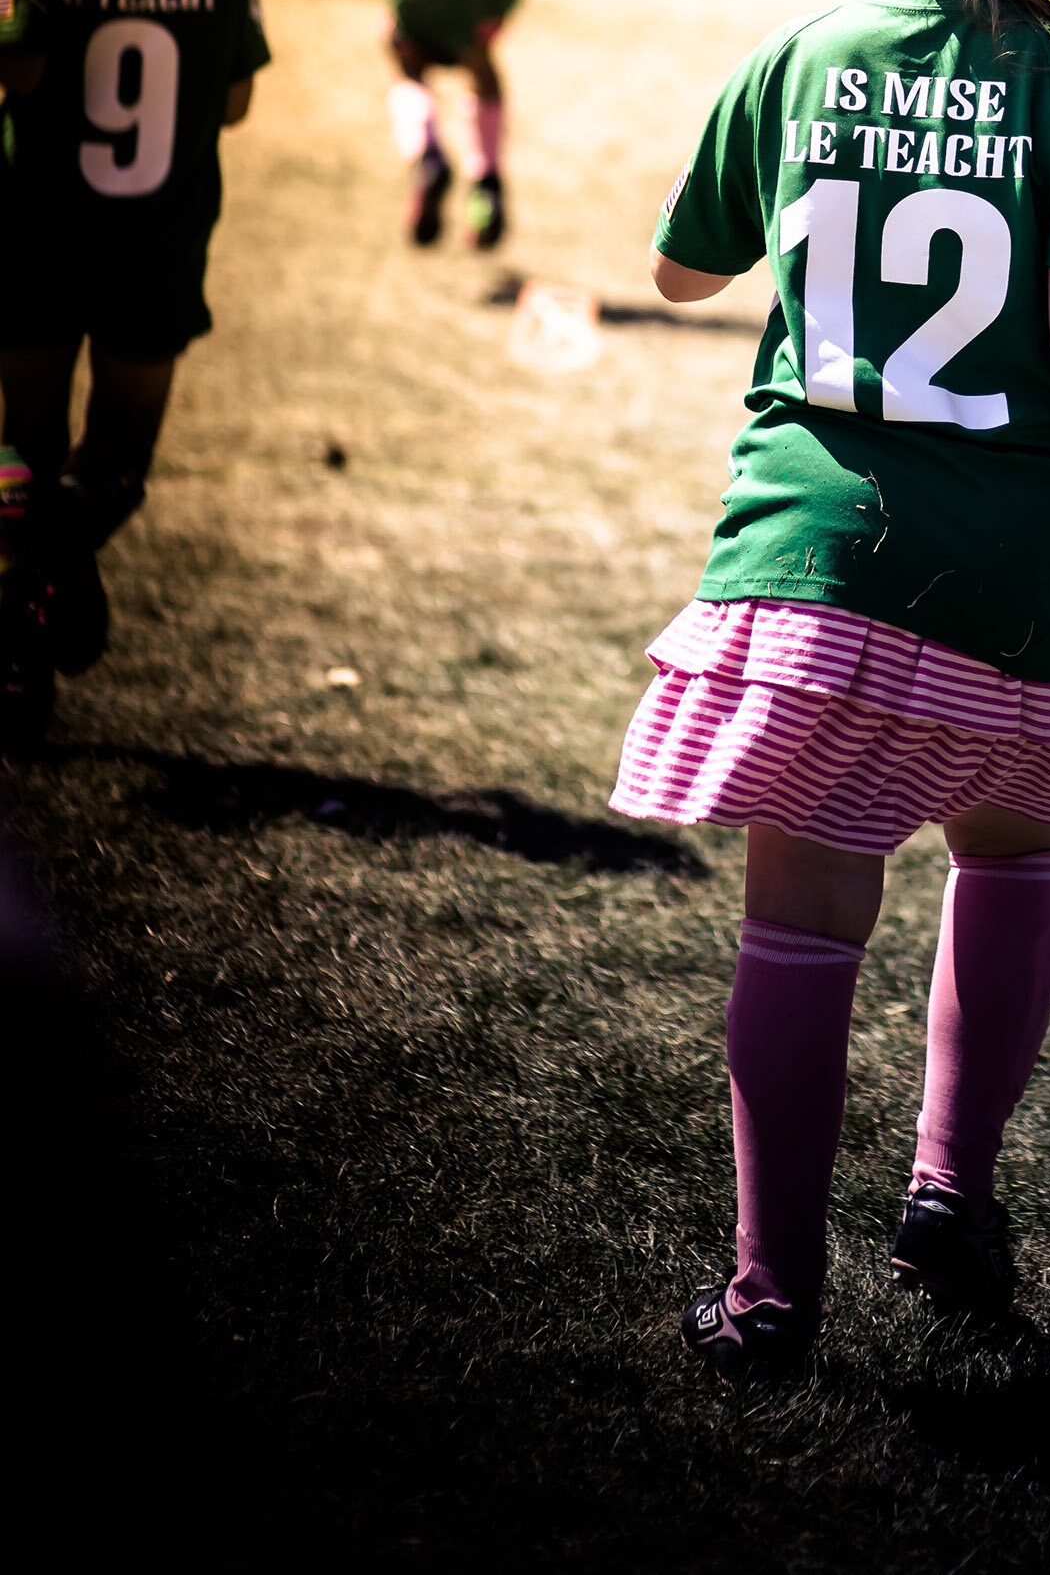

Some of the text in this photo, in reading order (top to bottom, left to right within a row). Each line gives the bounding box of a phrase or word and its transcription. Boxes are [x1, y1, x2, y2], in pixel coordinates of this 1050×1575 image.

[78, 17, 180, 197] 9
[782, 120, 1033, 180] LE TEACHT
[822, 67, 1007, 123] IS MISE
[779, 178, 1011, 431] 12
